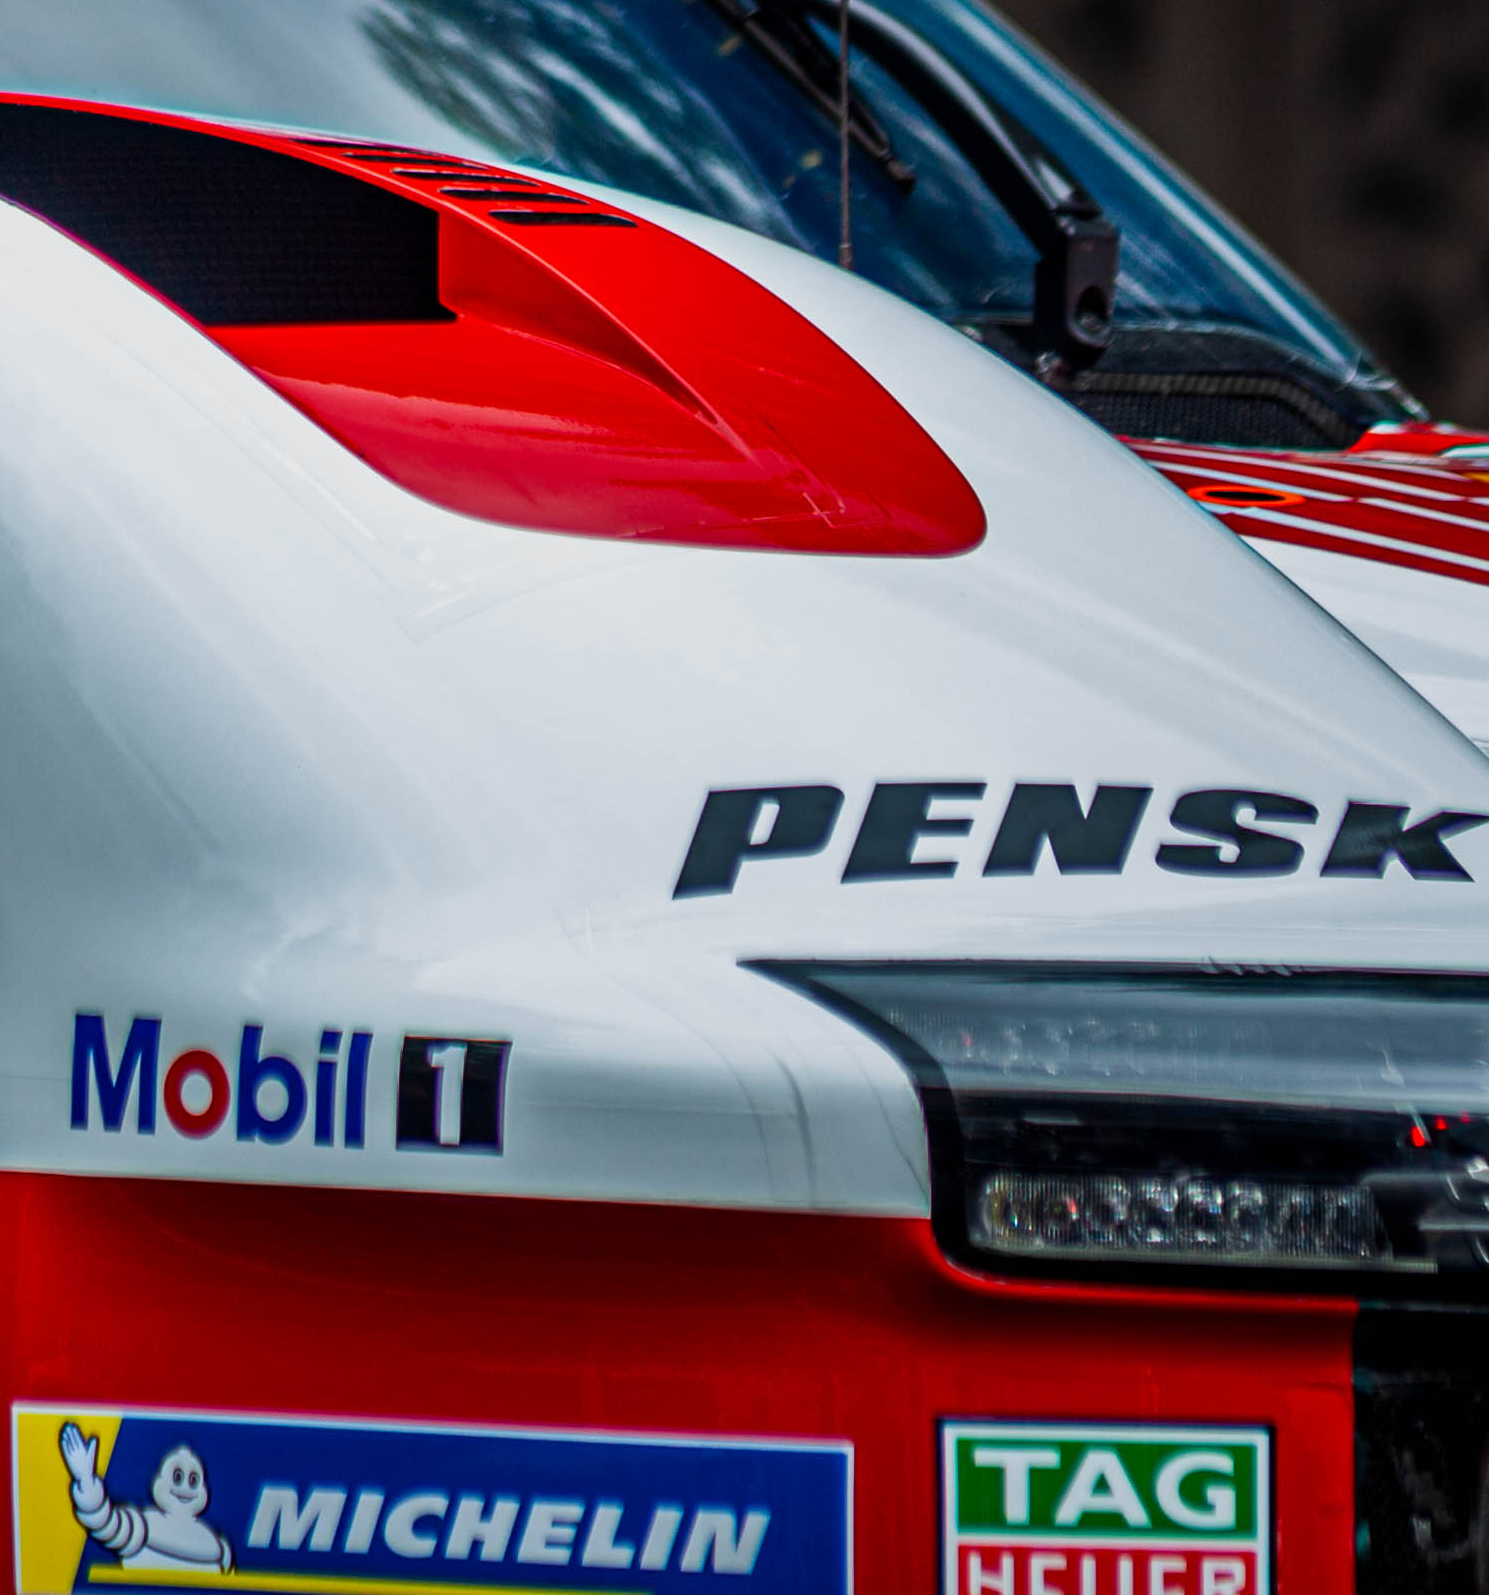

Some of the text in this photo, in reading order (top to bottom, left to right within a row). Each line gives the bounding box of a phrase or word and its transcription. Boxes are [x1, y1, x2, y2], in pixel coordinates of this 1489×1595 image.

[672, 780, 1489, 900] PENSK
[70, 1012, 374, 1149] Mobil
[246, 1483, 773, 1576] MICHELIN
[973, 1446, 1238, 1531] TAG
